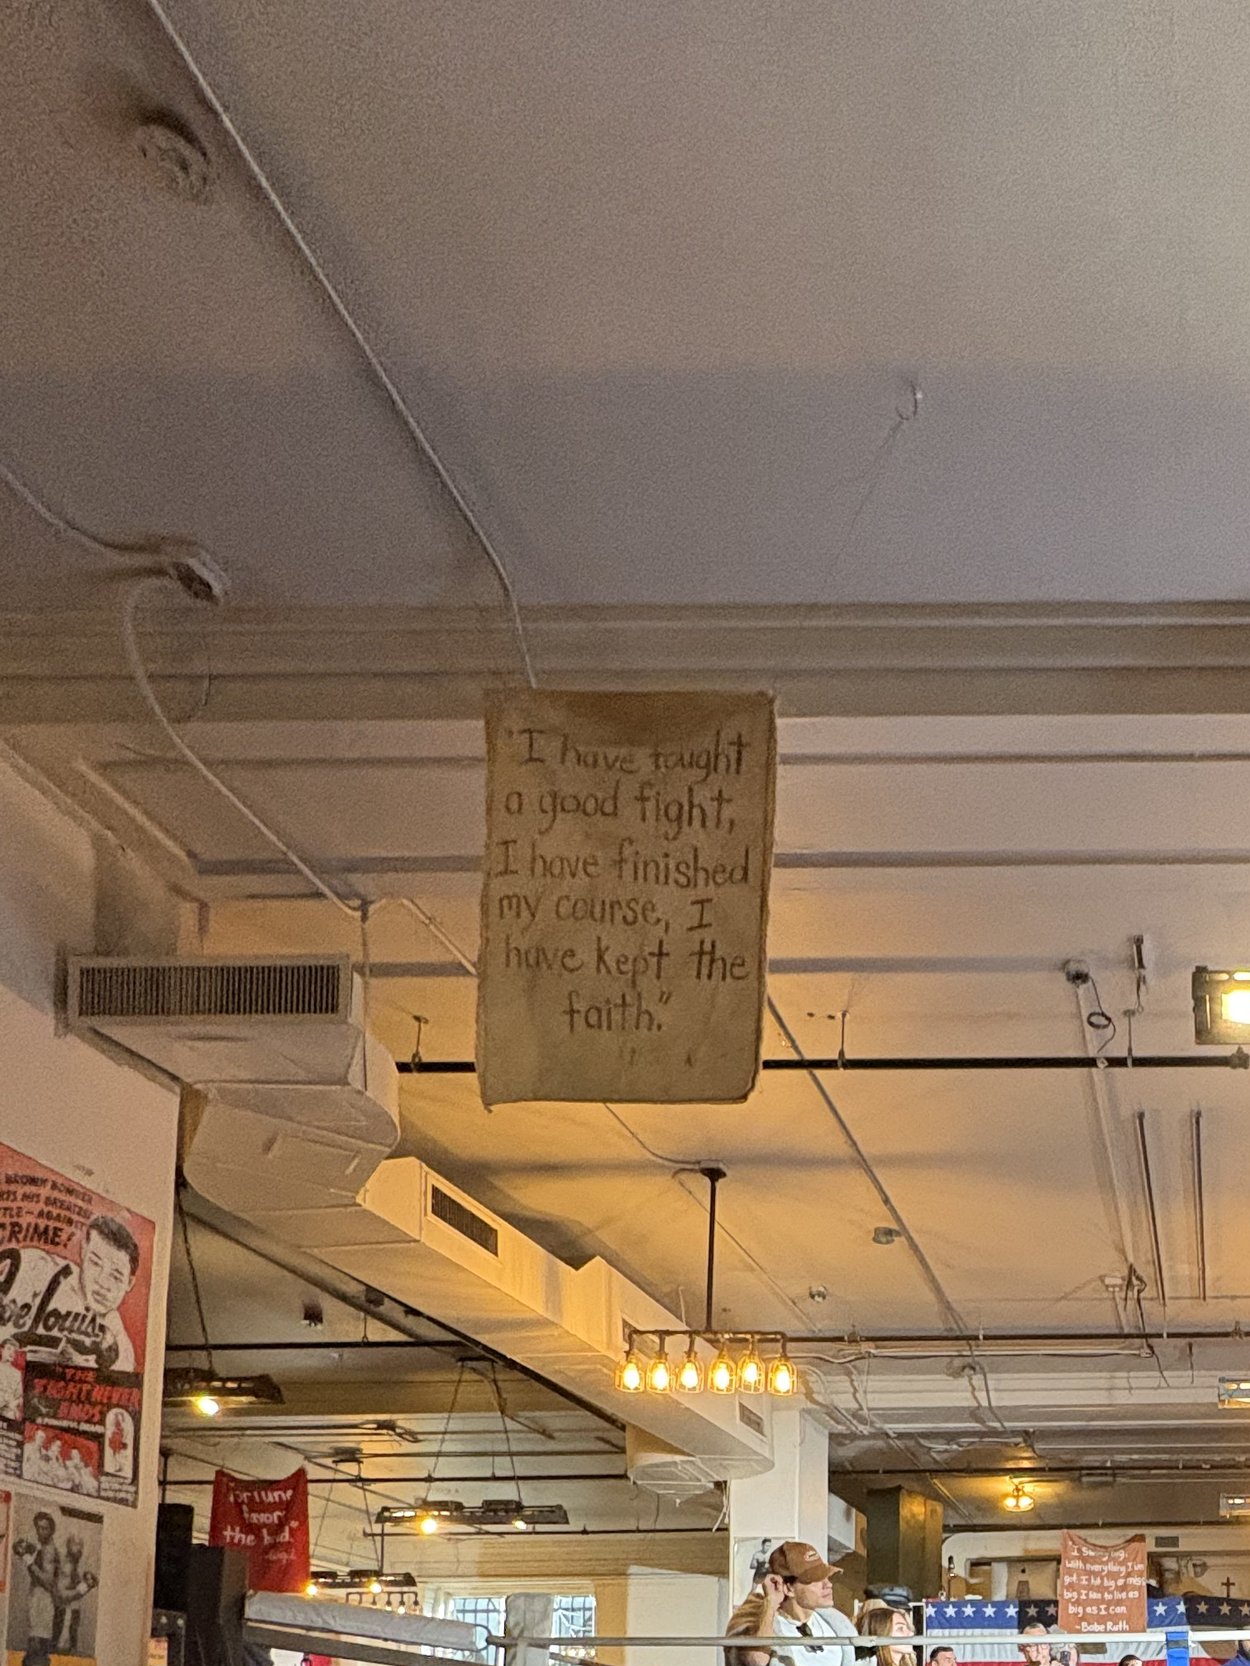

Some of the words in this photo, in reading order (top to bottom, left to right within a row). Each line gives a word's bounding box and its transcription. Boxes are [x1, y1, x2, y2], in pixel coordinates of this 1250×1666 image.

[561, 730, 639, 774] have
[505, 790, 523, 814] a
[538, 779, 619, 834] good
[635, 781, 735, 842] fight,
[497, 840, 519, 876] I
[530, 842, 600, 880] have
[613, 837, 749, 886] finished
[499, 893, 538, 932] my
[555, 895, 670, 935] course,
[687, 898, 714, 932] I
[504, 936, 583, 973] have
[596, 937, 670, 987] kept
[689, 939, 749, 982] the
[222, 1525, 256, 1545] the
[1063, 1589, 1078, 1601] big
[1080, 1590, 1088, 1599] I
[1104, 1591, 1113, 1600] to
[1080, 1575, 1088, 1585] I
[1068, 1603, 1083, 1618] big
[1086, 1606, 1098, 1614] as
[1099, 1604, 1108, 1615] I
[1107, 1620, 1129, 1632] Ruth
